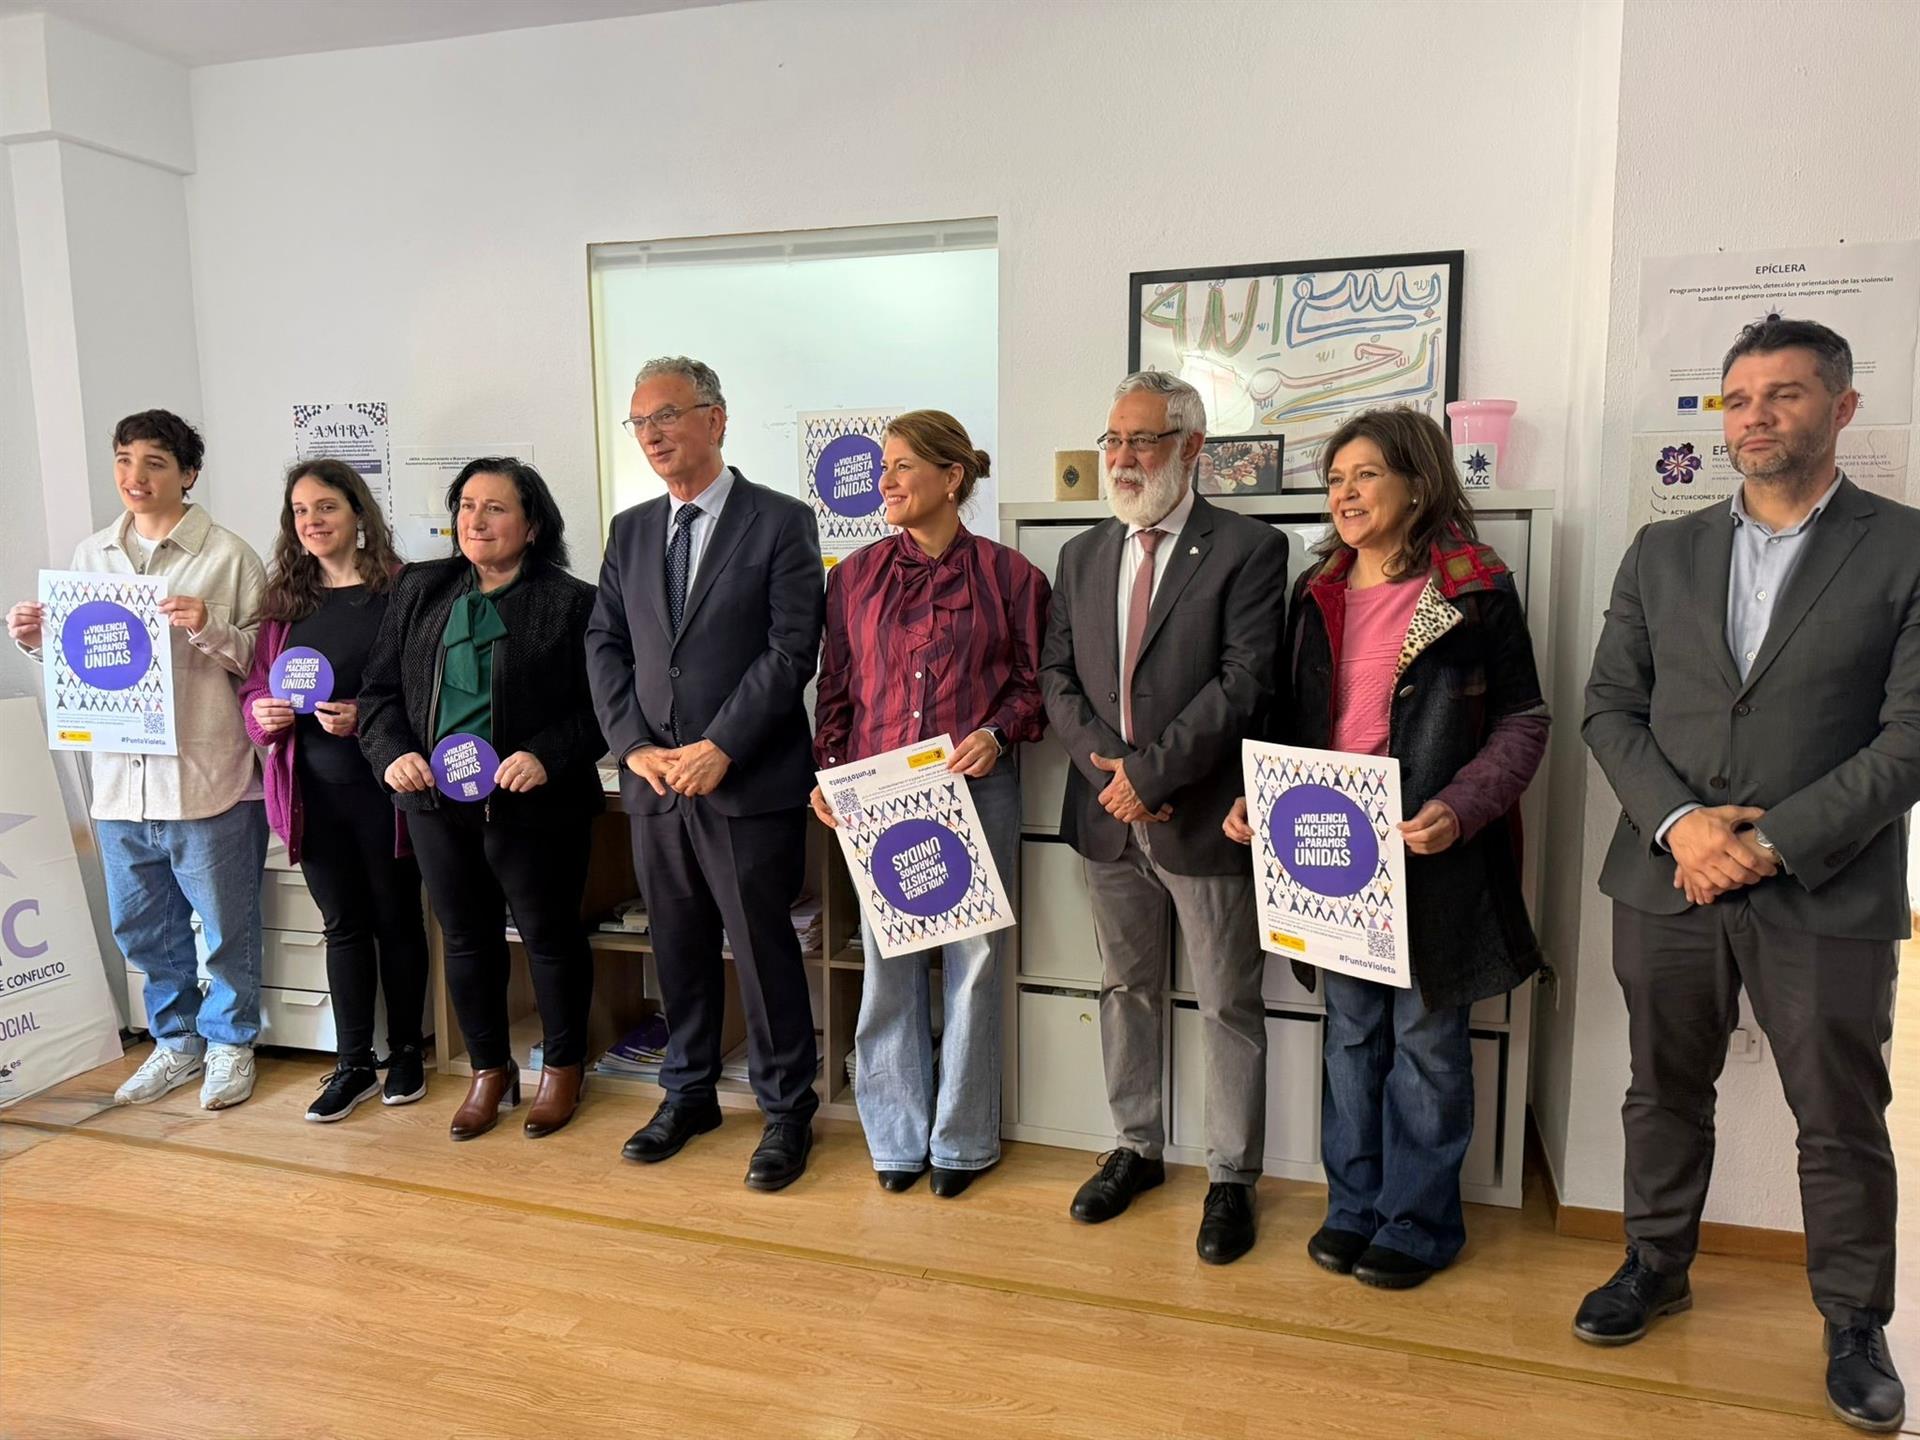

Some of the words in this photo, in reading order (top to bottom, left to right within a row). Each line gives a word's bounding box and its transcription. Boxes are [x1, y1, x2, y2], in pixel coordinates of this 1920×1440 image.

[1756, 264, 1806, 275] EPÍCLERA
[839, 452, 872, 466] VIOLENCIA
[834, 460, 873, 477] MACHISTA
[841, 470, 870, 482] PARAMOS
[834, 478, 873, 499] UNIDAS
[1465, 475, 1489, 486] MZC
[89, 621, 128, 633] VIOLENCIA
[84, 630, 130, 646] MACHISTA
[93, 641, 127, 652] PARAMOS
[85, 650, 131, 669] UNIDAS
[281, 678, 317, 689] UNIDAS
[446, 761, 481, 783] UNIDAS
[1301, 813, 1348, 824] VIOLENCIA
[1294, 824, 1351, 837] MACHISTA
[1304, 838, 1347, 848] PARAMOS
[892, 836, 942, 871] UNIDAS
[1295, 848, 1351, 867] UNIDAS
[899, 861, 948, 892] MACHISTA
[900, 858, 936, 879] PARAMOS
[904, 876, 945, 900] VIOLENCIA
[0, 899, 48, 966] C
[1339, 954, 1396, 974] #PuntoVioleta
[7, 961, 65, 989] CONFLICTO
[0, 1012, 41, 1042] OCIAL
